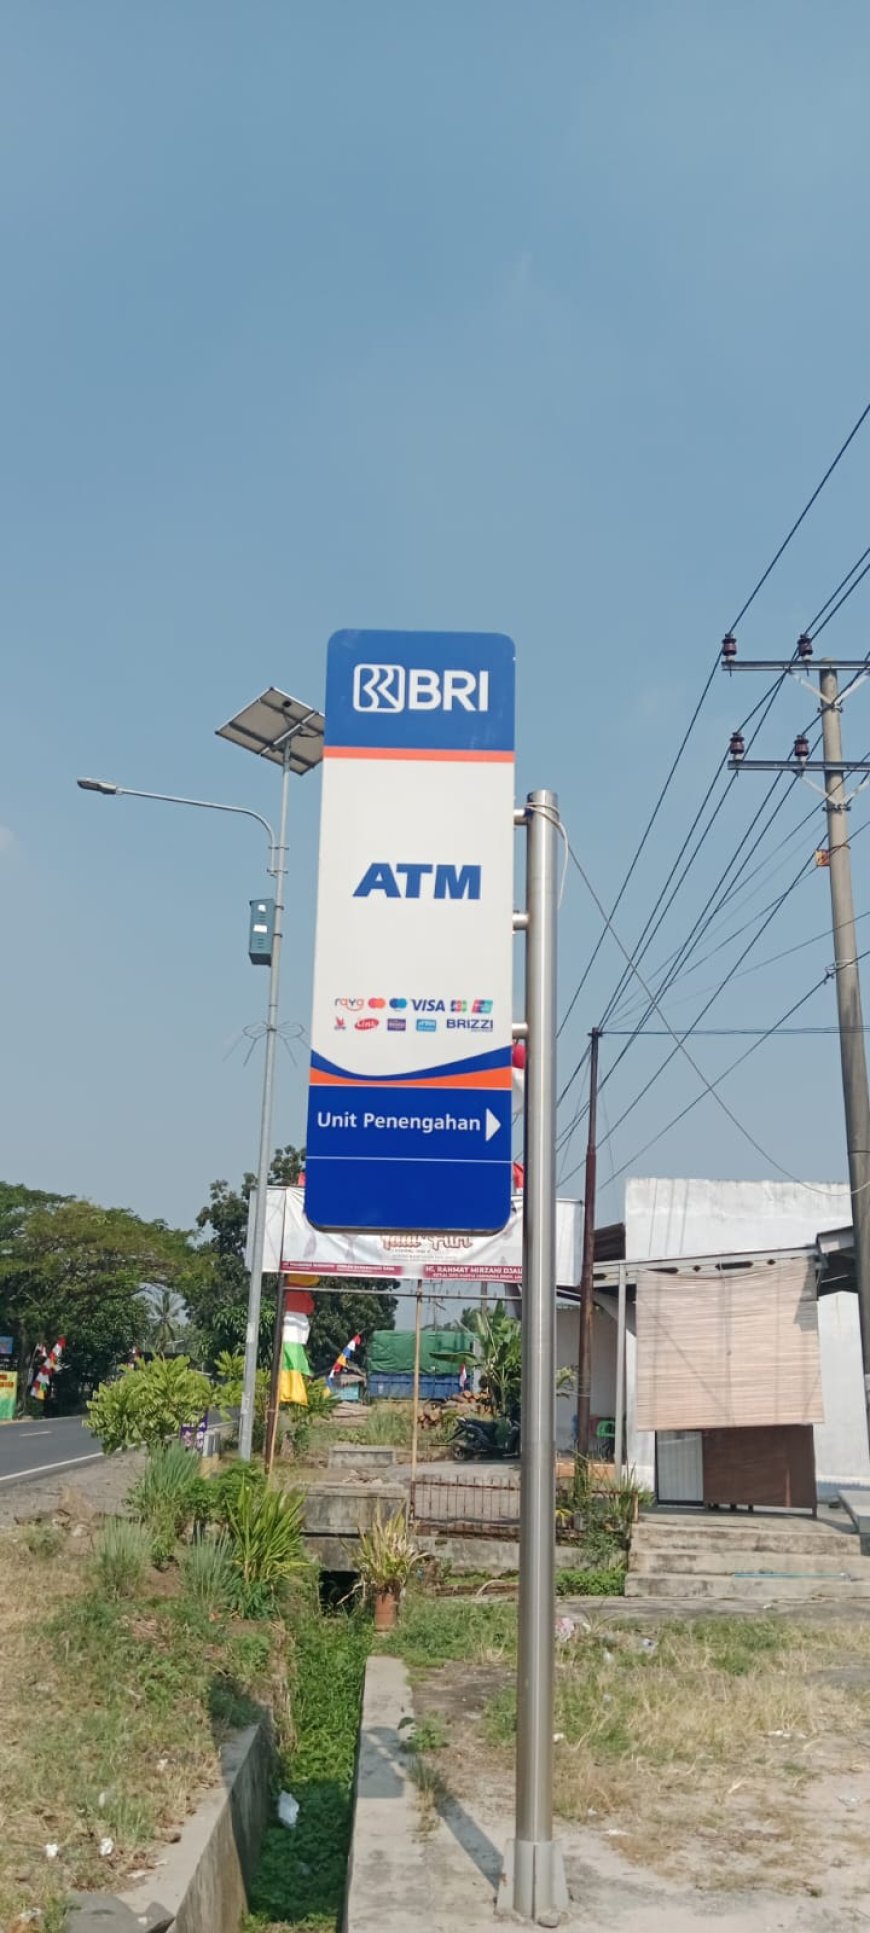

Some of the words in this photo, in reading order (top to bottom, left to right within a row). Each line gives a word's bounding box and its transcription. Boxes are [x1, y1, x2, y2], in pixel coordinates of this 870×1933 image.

[408, 669, 489, 712] BRI
[352, 863, 482, 900] ATM
[411, 999, 446, 1012] VISA
[446, 1018, 494, 1030] BRIZZI
[317, 1111, 358, 1128] Unit
[363, 1112, 481, 1134] Penengahan
